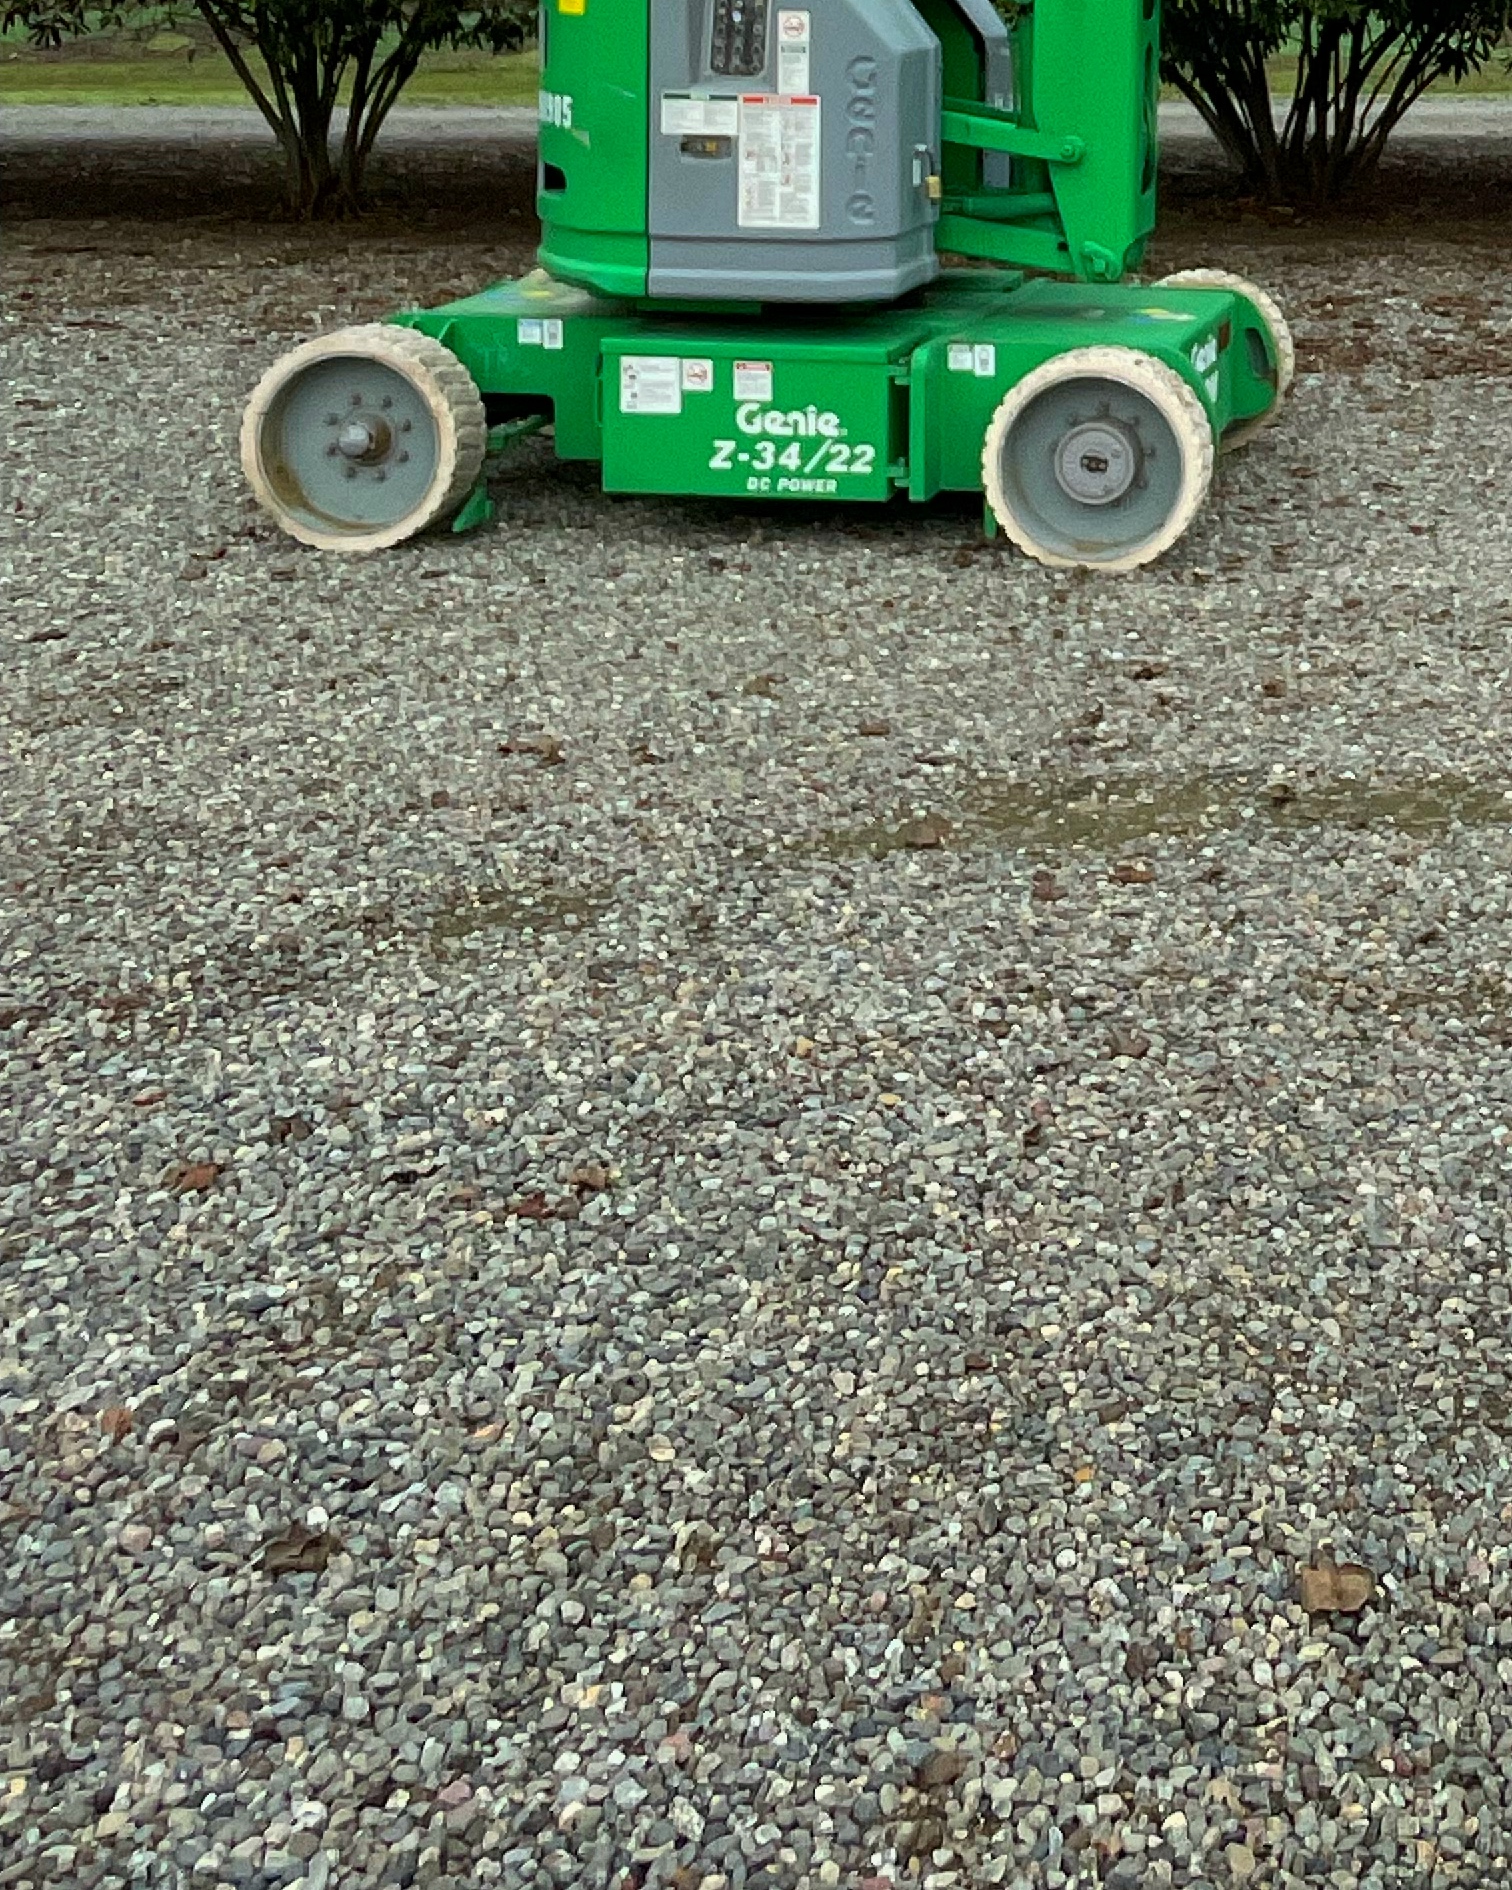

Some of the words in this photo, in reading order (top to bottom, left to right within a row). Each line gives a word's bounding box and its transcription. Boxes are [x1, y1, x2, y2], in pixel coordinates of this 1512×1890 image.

[736, 401, 841, 438] Genie
[708, 438, 876, 474] Z-34/22
[746, 476, 772, 491] DC
[777, 477, 838, 493] POWER
